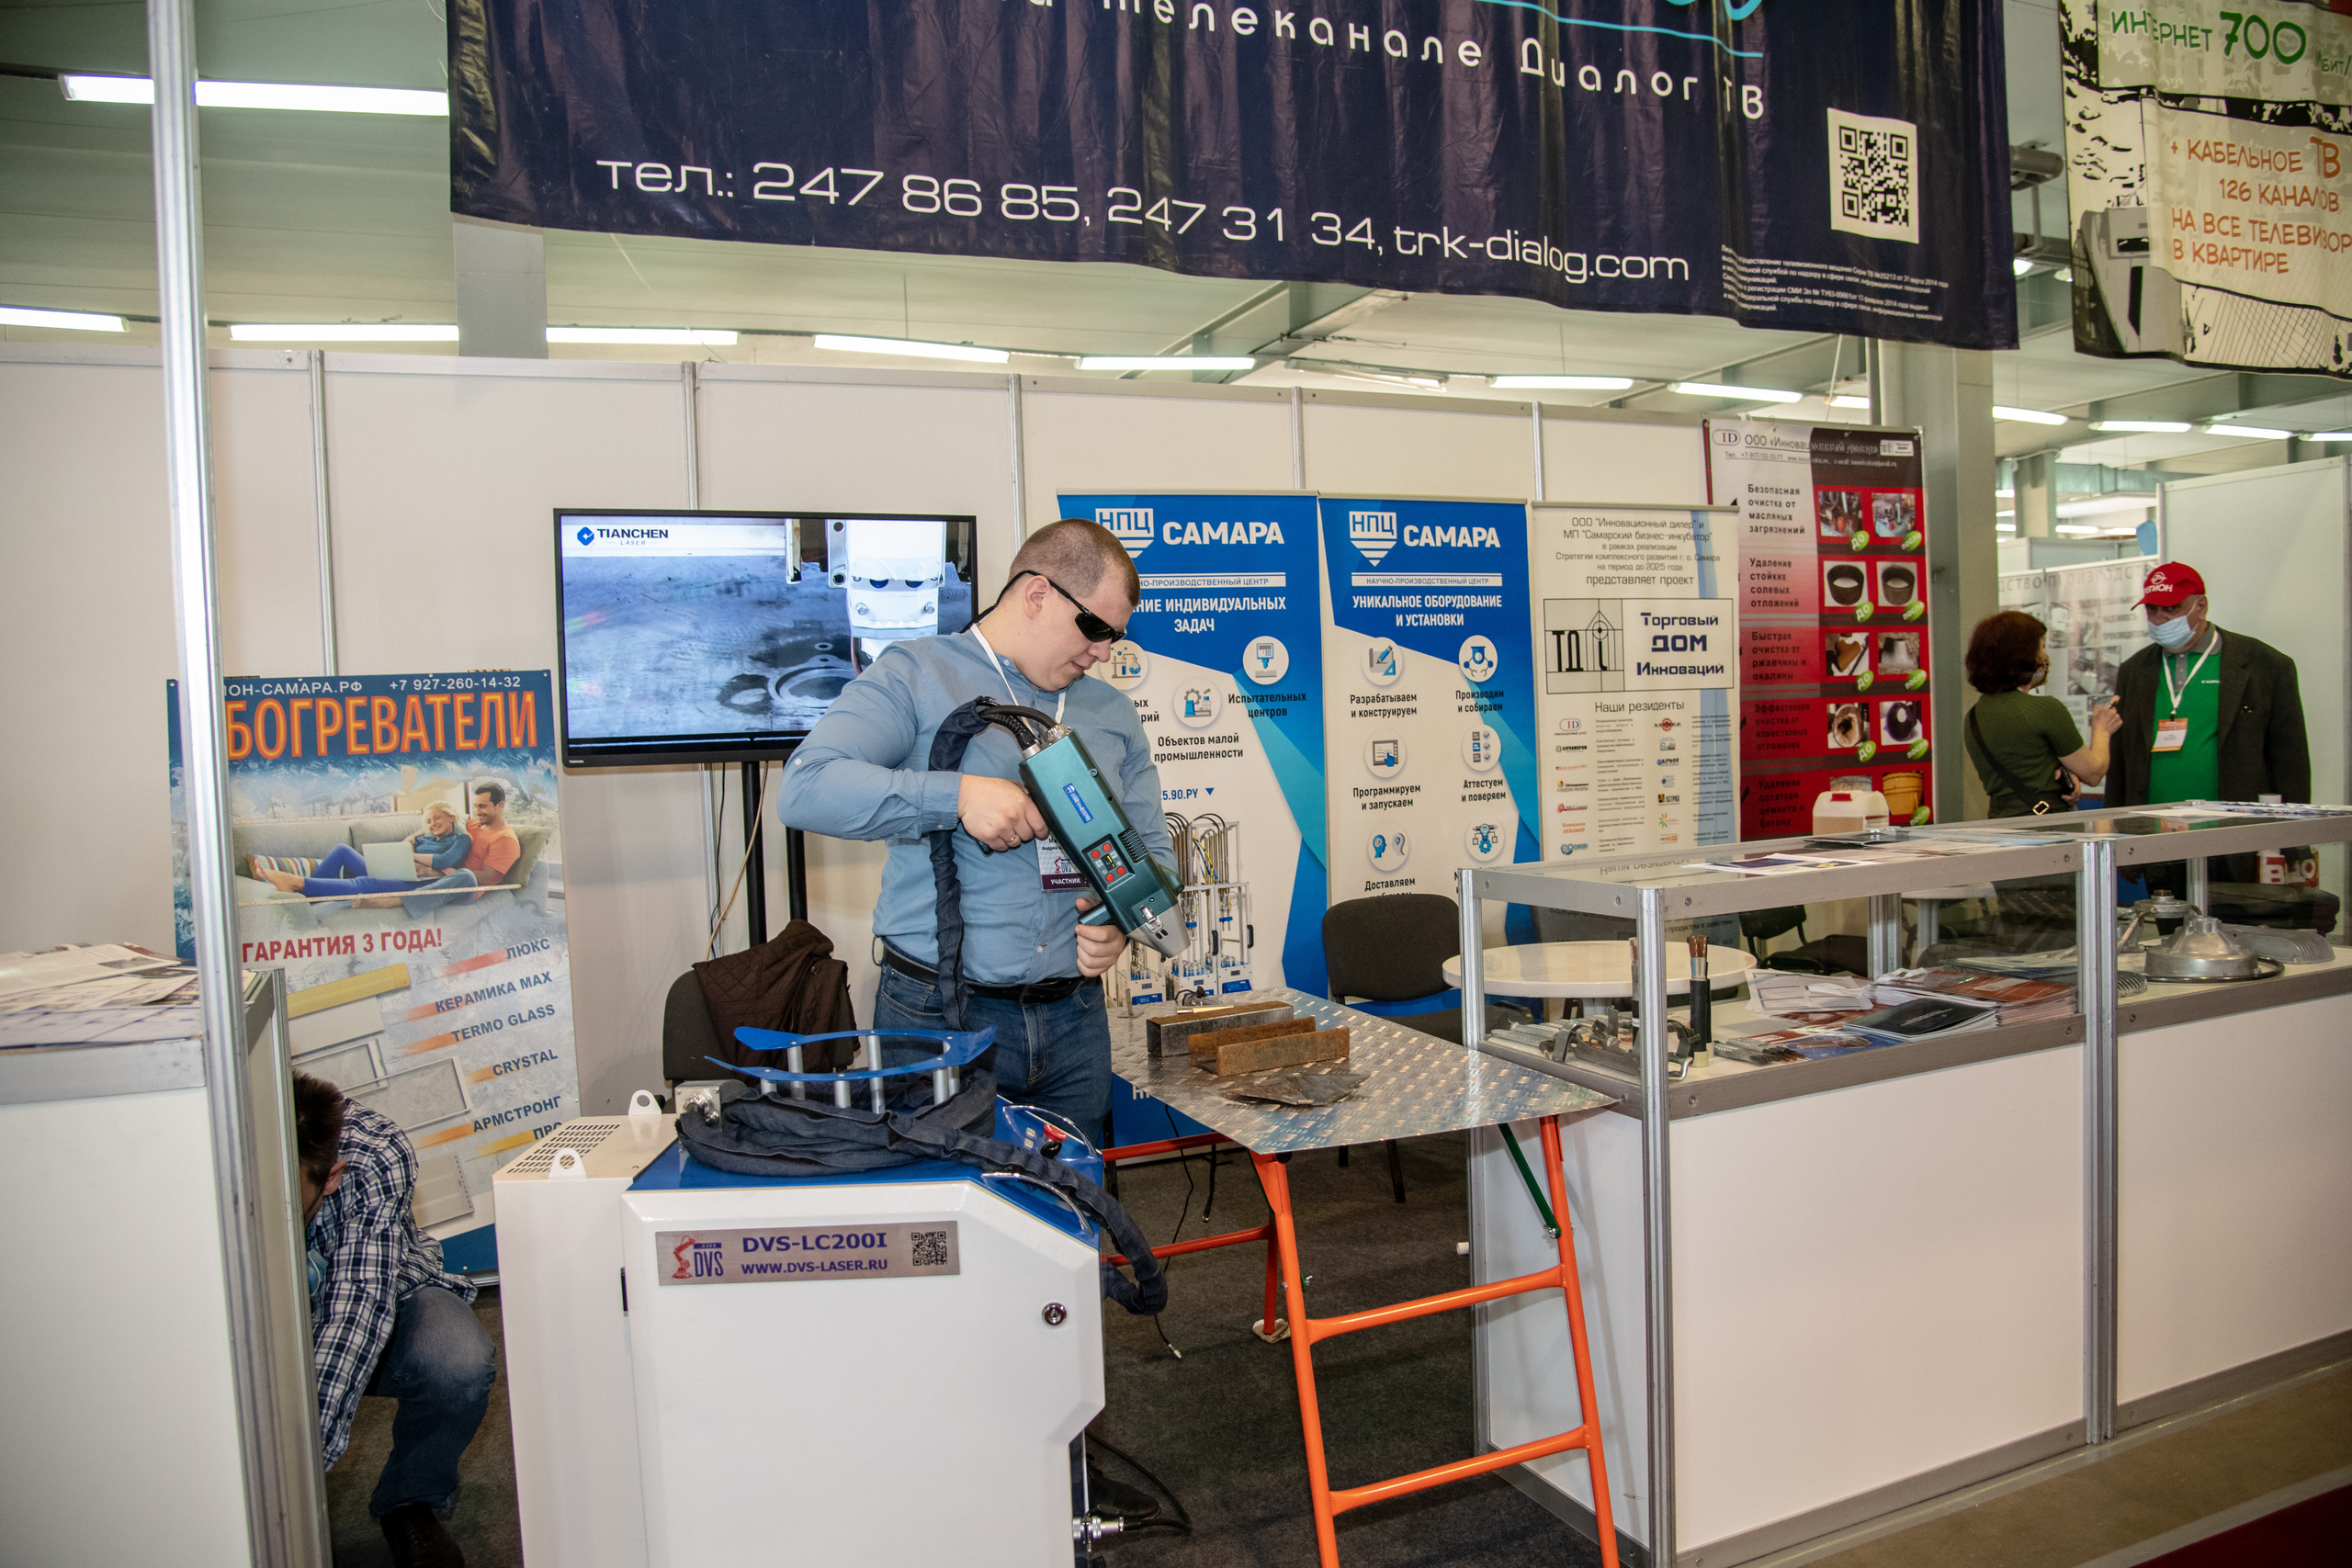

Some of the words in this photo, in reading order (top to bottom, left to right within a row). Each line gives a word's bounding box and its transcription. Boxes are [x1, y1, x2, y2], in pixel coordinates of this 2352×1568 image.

[2220, 11, 2306, 64] 700
[1521, 38, 1698, 100] Диалог
[2188, 139, 2303, 174] КАБЕЛЬНОЕ
[2309, 136, 2341, 179] ТВ
[2219, 178, 2252, 202] 126
[2258, 184, 2339, 213] КАНАЛОВ
[596, 160, 733, 197] тел.:
[752, 163, 884, 205] 247
[902, 175, 982, 216] 86
[1001, 183, 1091, 226] 85,
[1107, 187, 1206, 235] 247
[1223, 207, 1284, 242] 31
[1311, 212, 1384, 256] 34,
[1394, 225, 1689, 284] trk-dialog.com
[2172, 208, 2196, 232] НА
[2204, 212, 2242, 238] ВСЕ
[2173, 238, 2183, 260] В
[2192, 242, 2290, 274] КВАРТИРЕ
[1723, 433, 1737, 443] ID
[1745, 434, 1767, 446] ООО
[1748, 484, 1800, 495] Безопасная
[1748, 499, 1782, 508] очистка
[1572, 517, 1592, 527] ООО
[1749, 513, 1792, 522] масляных
[596, 528, 669, 539] TIANCHEN
[1162, 522, 1285, 546] САМАРА
[1351, 513, 1395, 536] НПЦ
[1403, 525, 1501, 548] САМАРА
[1563, 529, 1579, 539] МП
[1749, 525, 1804, 536] загрязнений
[1609, 544, 1634, 552] рамках
[1636, 544, 1678, 552] реализации
[1555, 552, 1594, 562] Стратегии
[1595, 553, 1645, 562] комплексного
[1646, 554, 1678, 562] развития
[1694, 553, 1720, 563] Самара
[1750, 558, 1792, 569] Удаление
[1608, 563, 1634, 572] период
[1635, 563, 1645, 571] до
[1645, 562, 1666, 571] 2025
[1243, 577, 1269, 586] ЦЕНТР
[1366, 577, 1467, 585] НАУЧНО-ПРОИЗВОДСТВЕННЫЙ
[1468, 577, 1489, 585] ЦЕНТР
[1586, 575, 1657, 587] представляет
[1659, 576, 1694, 587] проект
[1750, 571, 1786, 581] стойких
[1750, 585, 1790, 594] солевых
[1165, 596, 1286, 614] ИНДИВИДУАЛЬНЫХ
[1352, 595, 1422, 608] УНИКАЛЬНОЕ
[1424, 595, 1502, 609] ОБОРУДОВАНИЕ
[1750, 598, 1799, 608] отложений
[1174, 618, 1215, 634] ЗАДАЧ
[1396, 615, 1403, 626] И
[1406, 614, 1464, 626] УСТАНОВКИ
[1640, 612, 1718, 630] Торговый
[1752, 631, 1792, 641] Быстрая
[1752, 645, 1790, 654] очистка
[1636, 661, 1724, 677] Инноваций
[1752, 659, 1798, 669] ржавчины
[1752, 671, 1793, 681] окалины
[390, 680, 408, 692] +7
[413, 676, 521, 691] 927-260-14-32
[1228, 693, 1306, 705] Испытательных
[1350, 693, 1417, 706] Разрабатываем
[1455, 690, 1504, 701] Производим
[1248, 707, 1287, 718] центров
[1351, 710, 1356, 718] и
[1358, 706, 1417, 718] конструируем
[1458, 705, 1463, 713] и
[1464, 703, 1503, 713] собираем
[1595, 702, 1625, 713] Наши
[1628, 701, 1684, 715] резиденты
[1754, 703, 1810, 714] Эффективная
[1755, 716, 1789, 726] очистка
[1792, 716, 1799, 724] от
[1158, 735, 1205, 748] Объектов
[1208, 732, 1239, 745] малой
[1154, 748, 1243, 762] промышленности
[1464, 779, 1503, 791] Аттестуем
[1758, 779, 1801, 790] Удаление
[1352, 784, 1421, 799] Программируем
[1461, 794, 1466, 802] и
[1468, 791, 1506, 803] поверяем
[1759, 793, 1799, 802] остатков
[1362, 802, 1367, 810] и
[1369, 798, 1413, 811] запускаем
[1364, 877, 1415, 892] Доставляем
[242, 934, 356, 963] ГАРАНТИЯ
[363, 933, 374, 953] 3
[380, 928, 443, 952] ГОДА!
[506, 938, 550, 960] ЛЮКС
[435, 981, 516, 1013] КЕРАМИКА
[451, 1019, 503, 1043] TERMO
[507, 1003, 556, 1027] GLASS
[492, 1048, 559, 1077] CRYSTAL
[473, 1095, 562, 1133] АРМСТРОНГ
[742, 1232, 888, 1253] DVS-LC200I
[694, 1250, 724, 1277] DVS
[741, 1259, 888, 1275] WWW.DVS-LASER.RU
